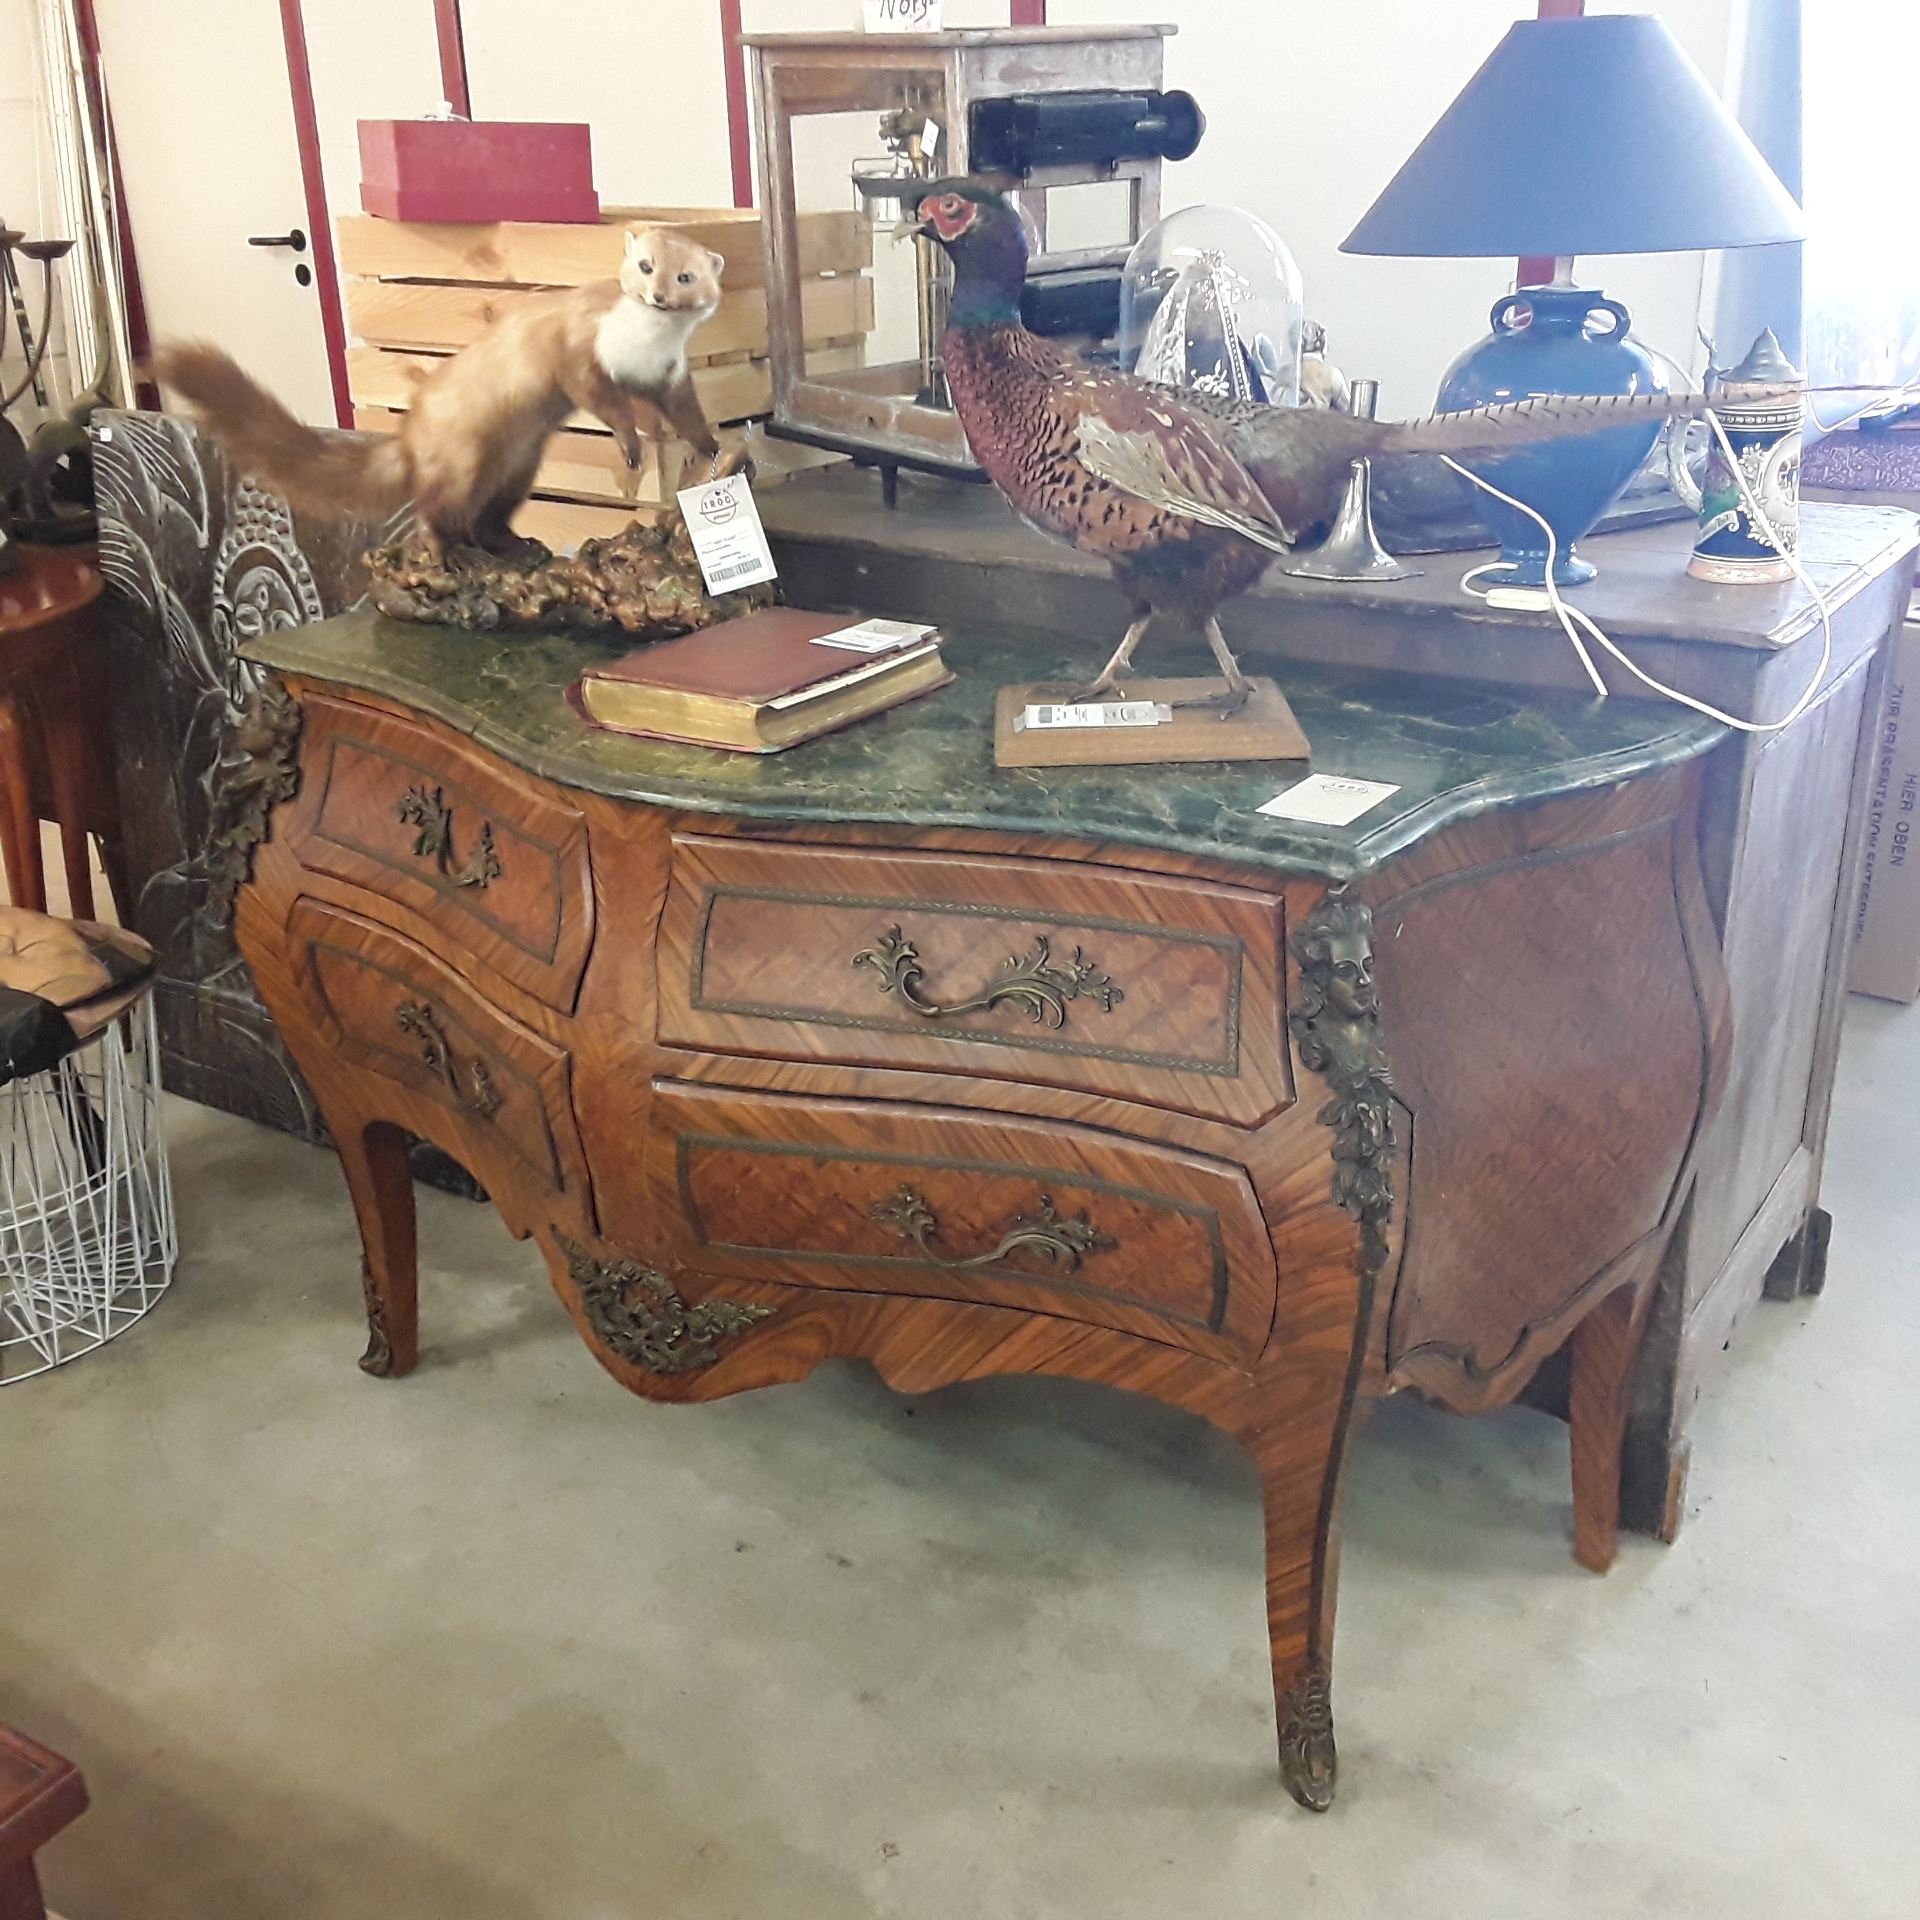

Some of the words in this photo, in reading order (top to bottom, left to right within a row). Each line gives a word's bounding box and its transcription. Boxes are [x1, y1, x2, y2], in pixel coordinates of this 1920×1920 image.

[1888, 684, 1904, 716] ZUR
[1901, 772, 1918, 811] HIER
[1890, 821, 1909, 866] OBEN
